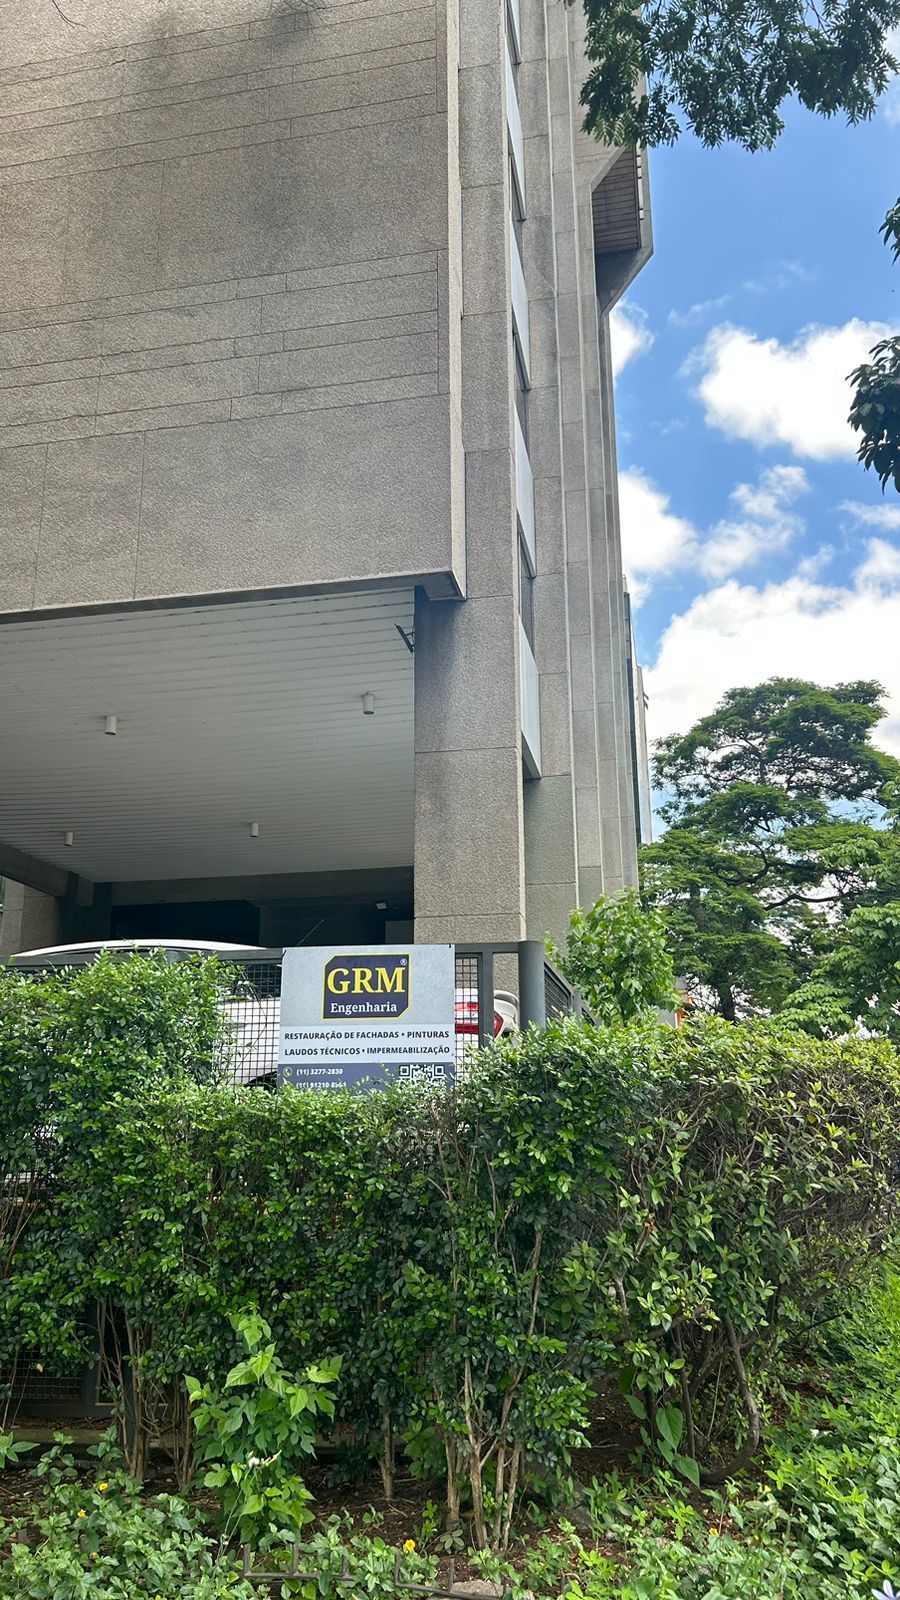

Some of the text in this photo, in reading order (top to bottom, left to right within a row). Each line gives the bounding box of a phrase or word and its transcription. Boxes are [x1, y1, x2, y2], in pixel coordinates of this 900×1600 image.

[327, 967, 406, 994] GRM
[330, 1002, 397, 1015] Engenharia
[284, 1031, 342, 1041] RESTAURAÇÃO
[356, 1031, 399, 1039] FACHADAS
[407, 1031, 450, 1039] PINTURAS
[284, 1045, 450, 1056] LAUDOS TÉCNICOS IMPERMEABILIZAÇÃO
[296, 1068, 309, 1077] (11)
